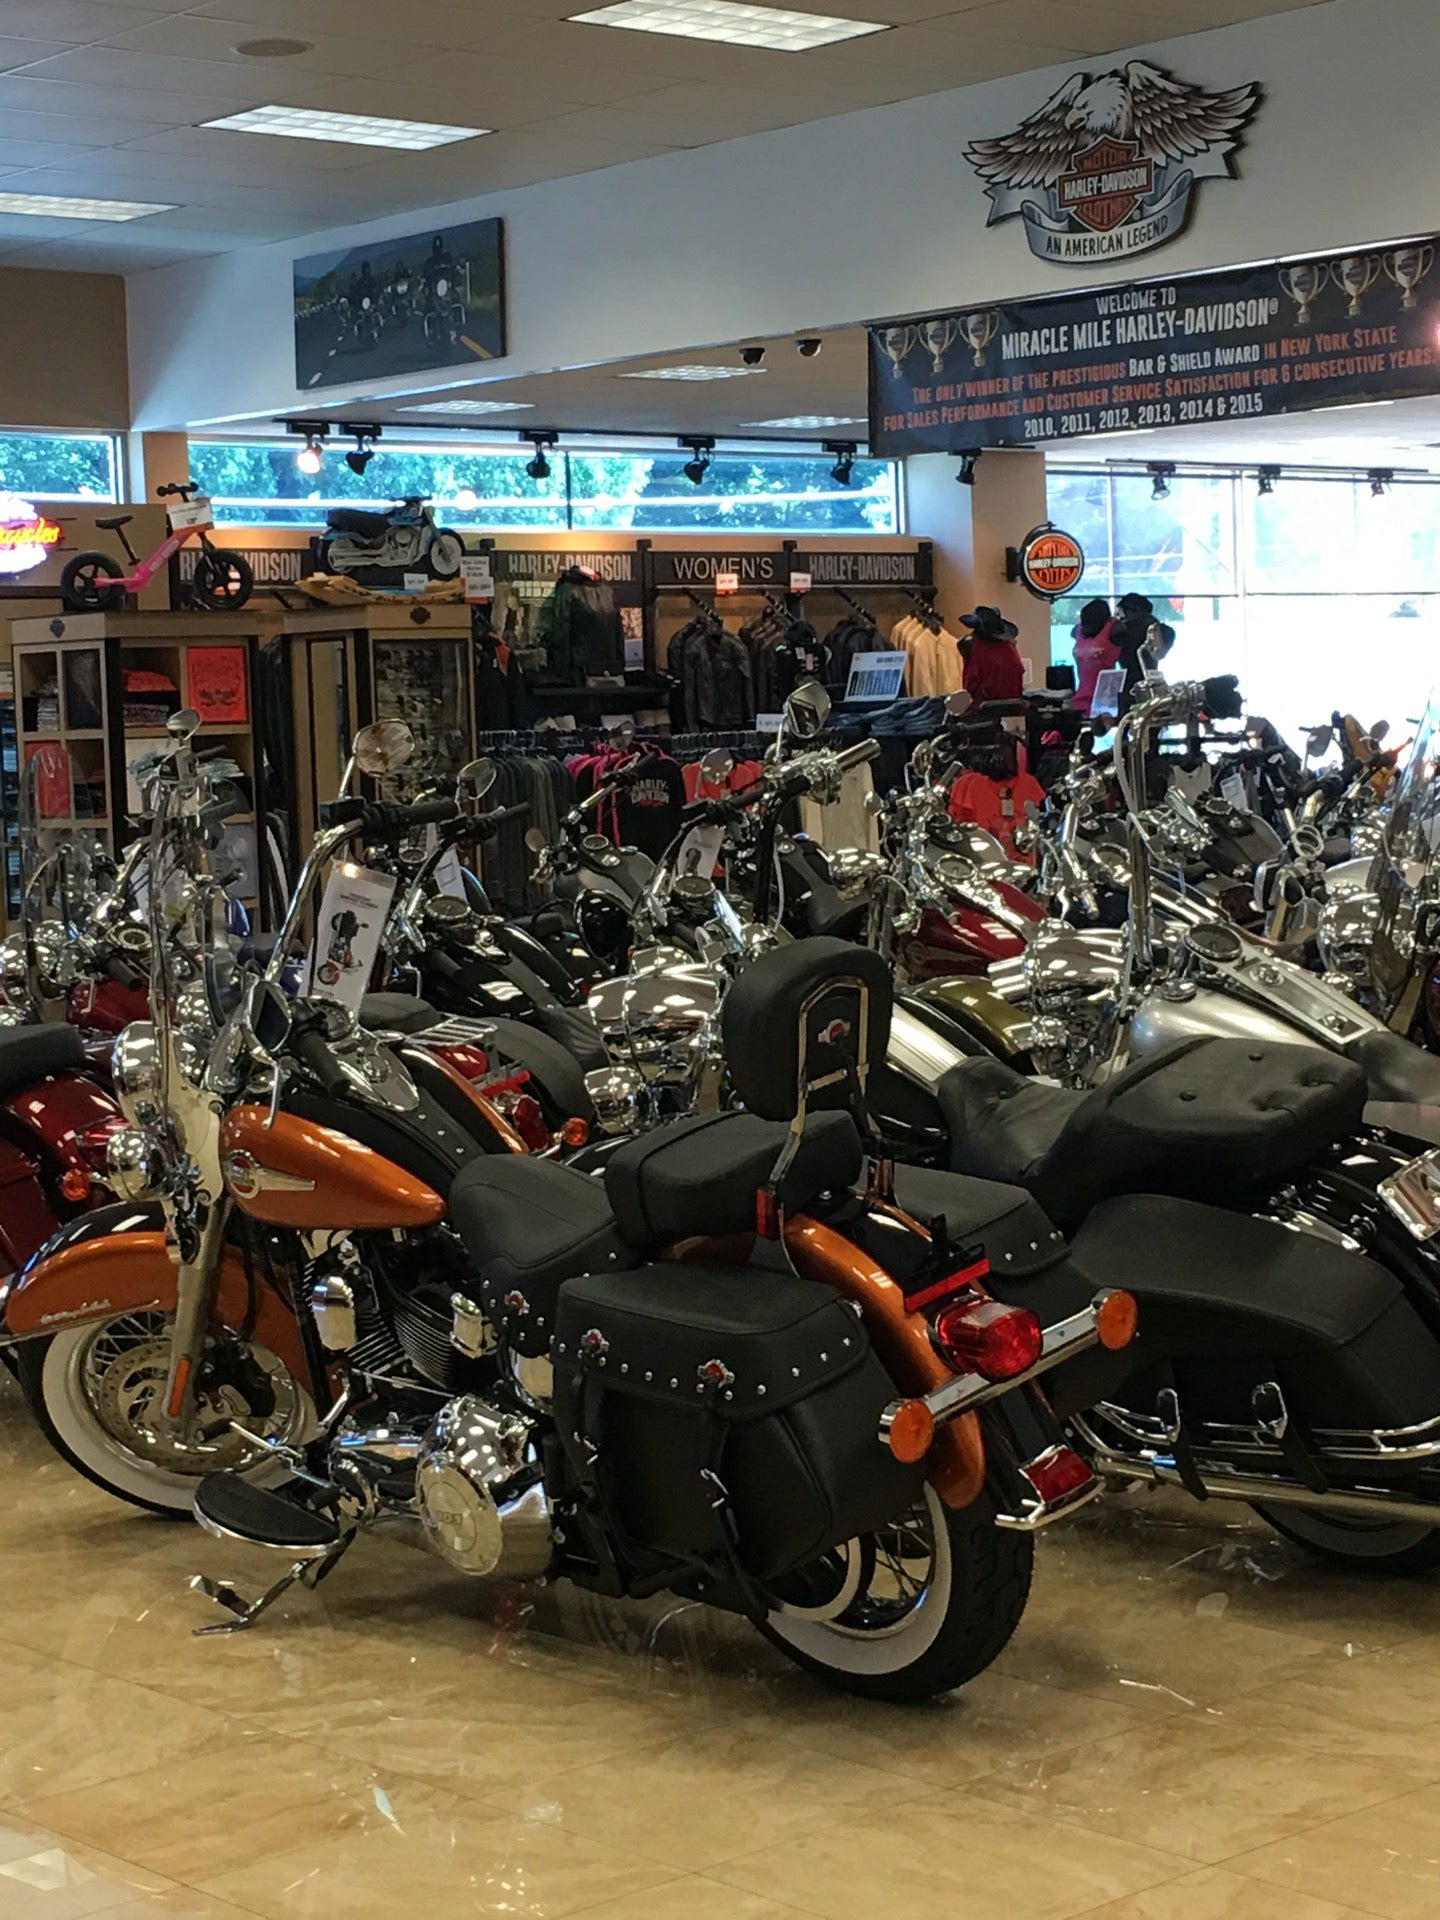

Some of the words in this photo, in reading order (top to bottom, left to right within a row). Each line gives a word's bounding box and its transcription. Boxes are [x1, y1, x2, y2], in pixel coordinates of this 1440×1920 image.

[1083, 147, 1128, 169] MOTOR
[1064, 167, 1148, 200] HARLEY-DAVIDSON
[1046, 235, 1061, 256] AN
[1064, 232, 1123, 257] AMERICAN
[1127, 215, 1169, 248] LEGEND
[1096, 288, 1157, 316] WELCOME
[1160, 286, 1176, 305] TO
[1001, 327, 1068, 360] MIRACLE
[1073, 321, 1111, 351] MILE
[912, 386, 932, 405] THE
[935, 383, 962, 403] ONLY
[964, 377, 1010, 399] WINNER
[1012, 375, 1024, 392] OF
[1028, 370, 1049, 389] THE
[1052, 362, 1127, 387] PRESTIGIOUS
[1129, 357, 1154, 378] BAR
[1157, 358, 1166, 373] &
[1170, 350, 1212, 373] SHIELD
[1215, 343, 1260, 367] AWARD
[1264, 342, 1277, 360] IN
[1281, 337, 1311, 358] NEW
[1315, 331, 1350, 355] YORK
[1354, 325, 1397, 349] STATE
[884, 414, 904, 431] FOR
[907, 410, 939, 430] SALES
[941, 398, 1021, 424] PERFORMANCE
[1022, 395, 1044, 414] AND
[1047, 388, 1109, 412] CUSTOMER
[1112, 381, 1161, 403] SERVICE
[1165, 371, 1251, 398] SATISFACTION
[1254, 367, 1278, 387] FOR
[1281, 364, 1290, 383] 6
[1294, 353, 1385, 382] CONSECUTIVE
[1024, 417, 1058, 439] 2010,
[1061, 413, 1096, 434] 2011,
[1138, 400, 1175, 424] 2013,
[1180, 398, 1213, 420] 2014
[1217, 397, 1226, 416] &
[1230, 393, 1263, 413] 2015
[674, 557, 774, 579] WOMEN'S
[809, 555, 916, 581] HARLEY-DAVIDSON
